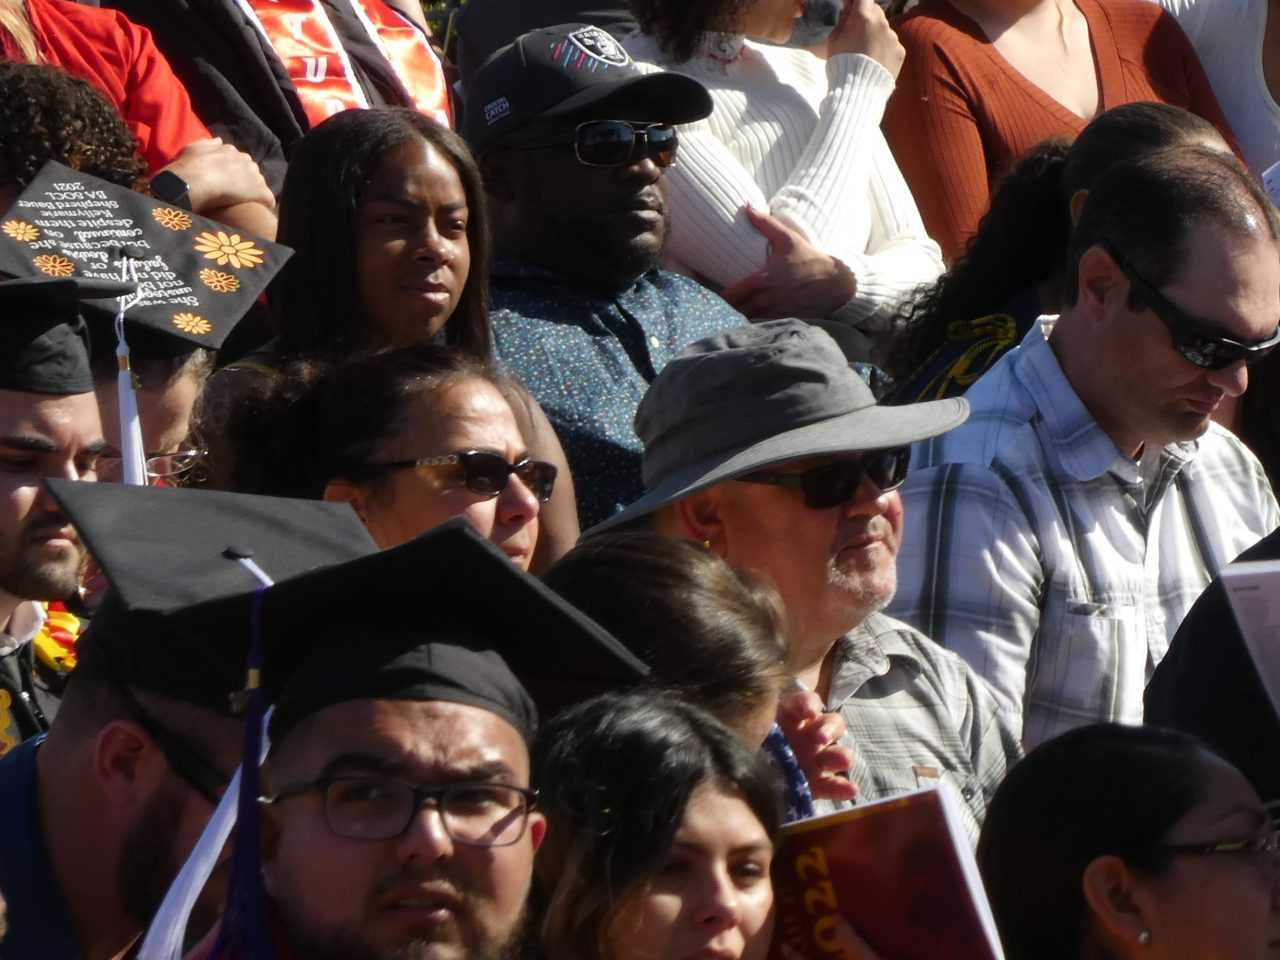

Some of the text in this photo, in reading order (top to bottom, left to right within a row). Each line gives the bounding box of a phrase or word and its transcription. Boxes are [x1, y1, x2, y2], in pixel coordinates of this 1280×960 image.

[53, 182, 86, 191] 2021
[84, 191, 108, 199] BA
[18, 199, 119, 210] Shepherd Bauer
[40, 209, 114, 218] Kellymarie
[34, 218, 134, 229] despite them
[43, 227, 143, 242] continued on
[28, 239, 57, 250] she
[59, 239, 121, 249] because
[89, 262, 108, 270] or
[82, 269, 121, 281] have
[151, 271, 176, 281] did
[159, 279, 184, 290] not
[168, 296, 199, 306] She
